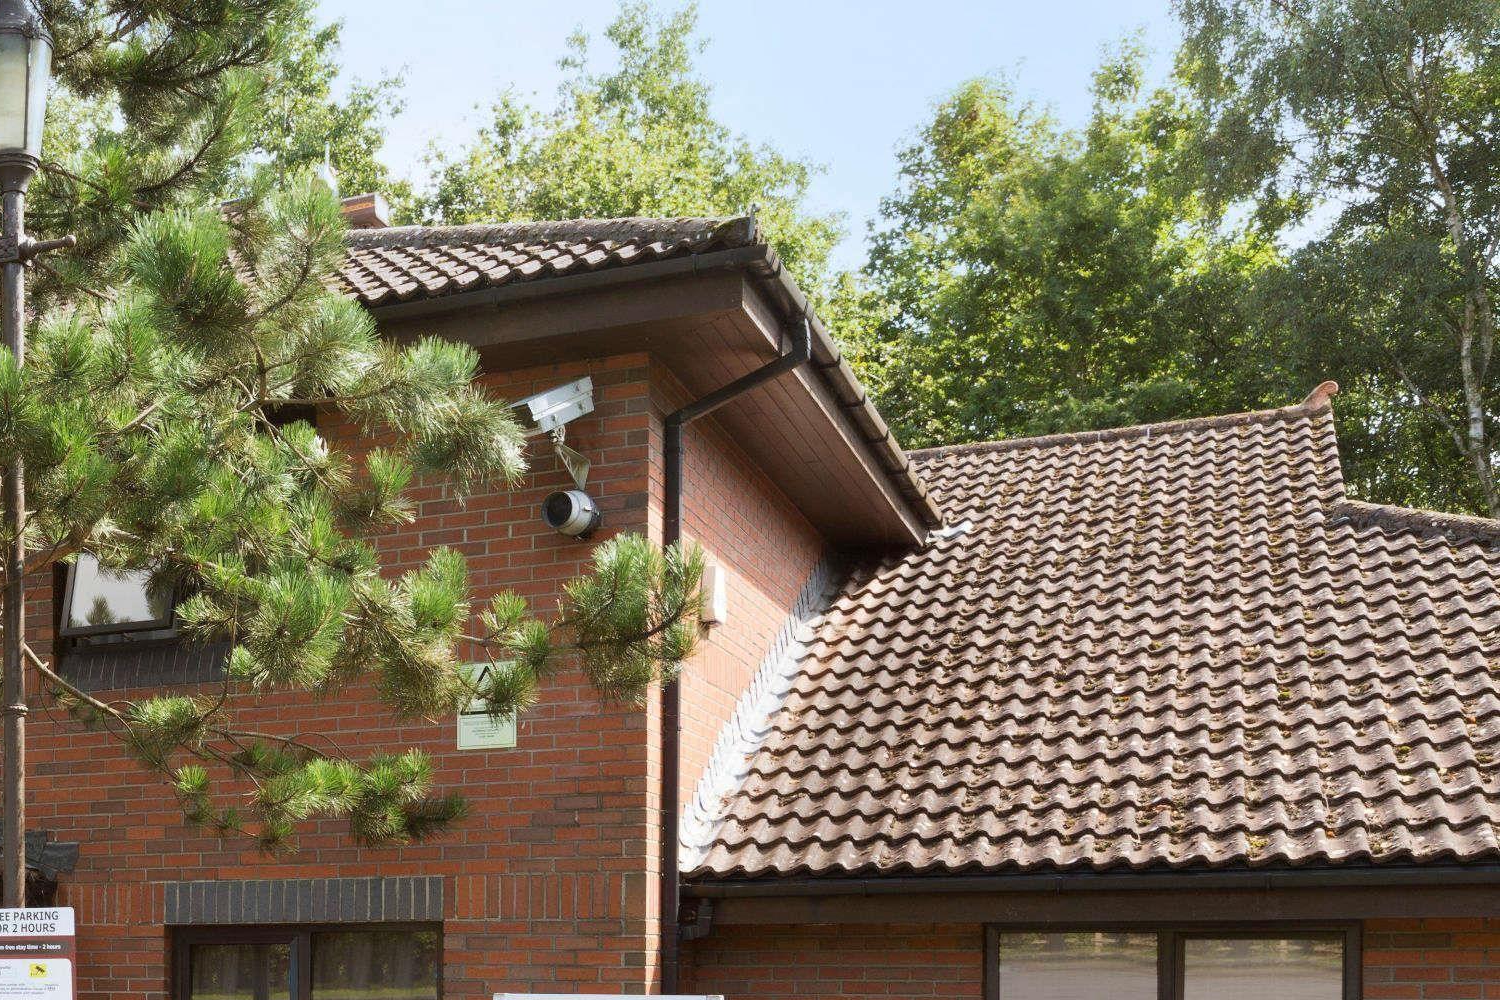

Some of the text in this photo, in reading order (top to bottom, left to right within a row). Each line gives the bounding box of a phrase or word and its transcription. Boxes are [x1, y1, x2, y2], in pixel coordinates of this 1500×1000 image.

[13, 911, 59, 921] PARKING
[12, 923, 18, 933] 2
[21, 923, 56, 933] HOURS
[16, 944, 27, 952] stay
